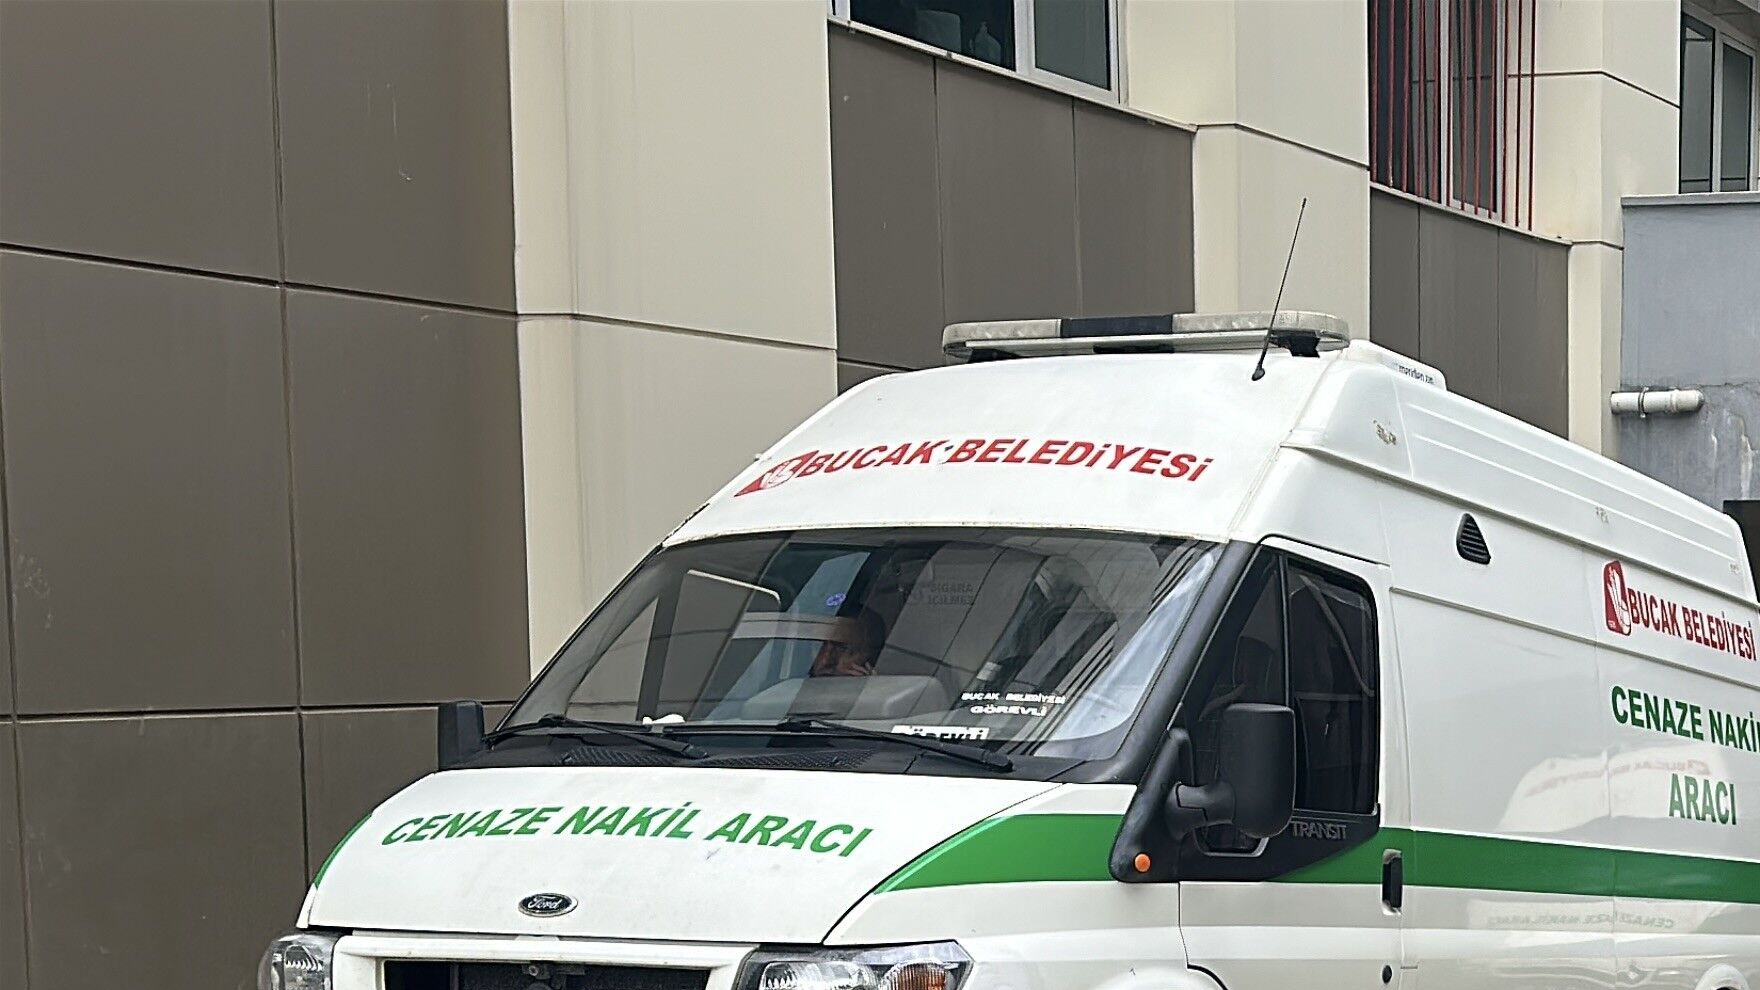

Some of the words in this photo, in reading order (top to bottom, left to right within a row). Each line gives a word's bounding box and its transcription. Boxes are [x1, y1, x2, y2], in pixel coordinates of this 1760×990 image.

[795, 440, 949, 478] BUCAK
[1627, 588, 1682, 638] BUCAK
[1682, 607, 1757, 661] BELEDİYESİ
[1611, 685, 1704, 741] CENAZE
[1669, 773, 1737, 826] ARACI
[381, 806, 564, 847] CENAZE
[553, 801, 703, 840] NAKİL
[703, 812, 875, 858] ARACI
[1290, 821, 1347, 839] TRANSIT
